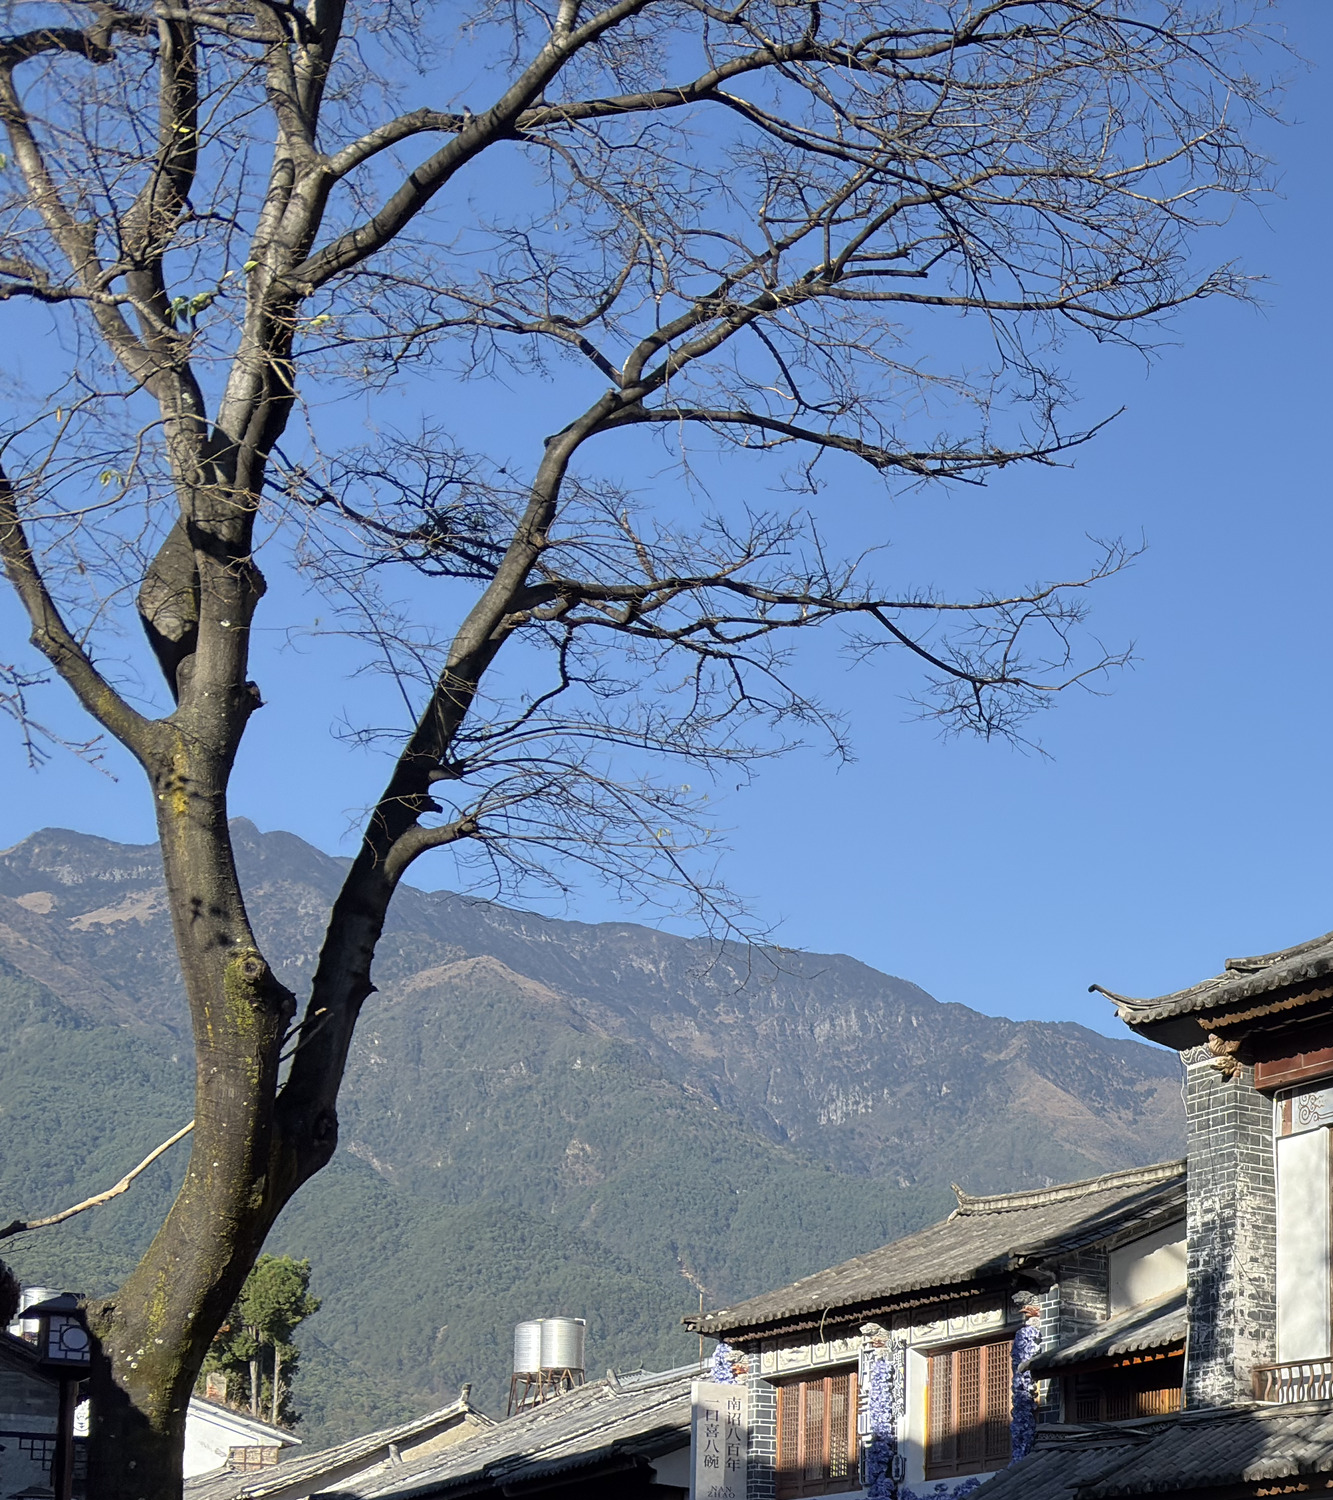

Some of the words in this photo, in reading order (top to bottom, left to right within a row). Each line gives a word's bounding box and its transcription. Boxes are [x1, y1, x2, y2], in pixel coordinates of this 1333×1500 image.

[703, 1399, 719, 1469] 一口喜八碗
[726, 1396, 741, 1472] 南诏八百年
[707, 1491, 735, 1499] ZHAO
